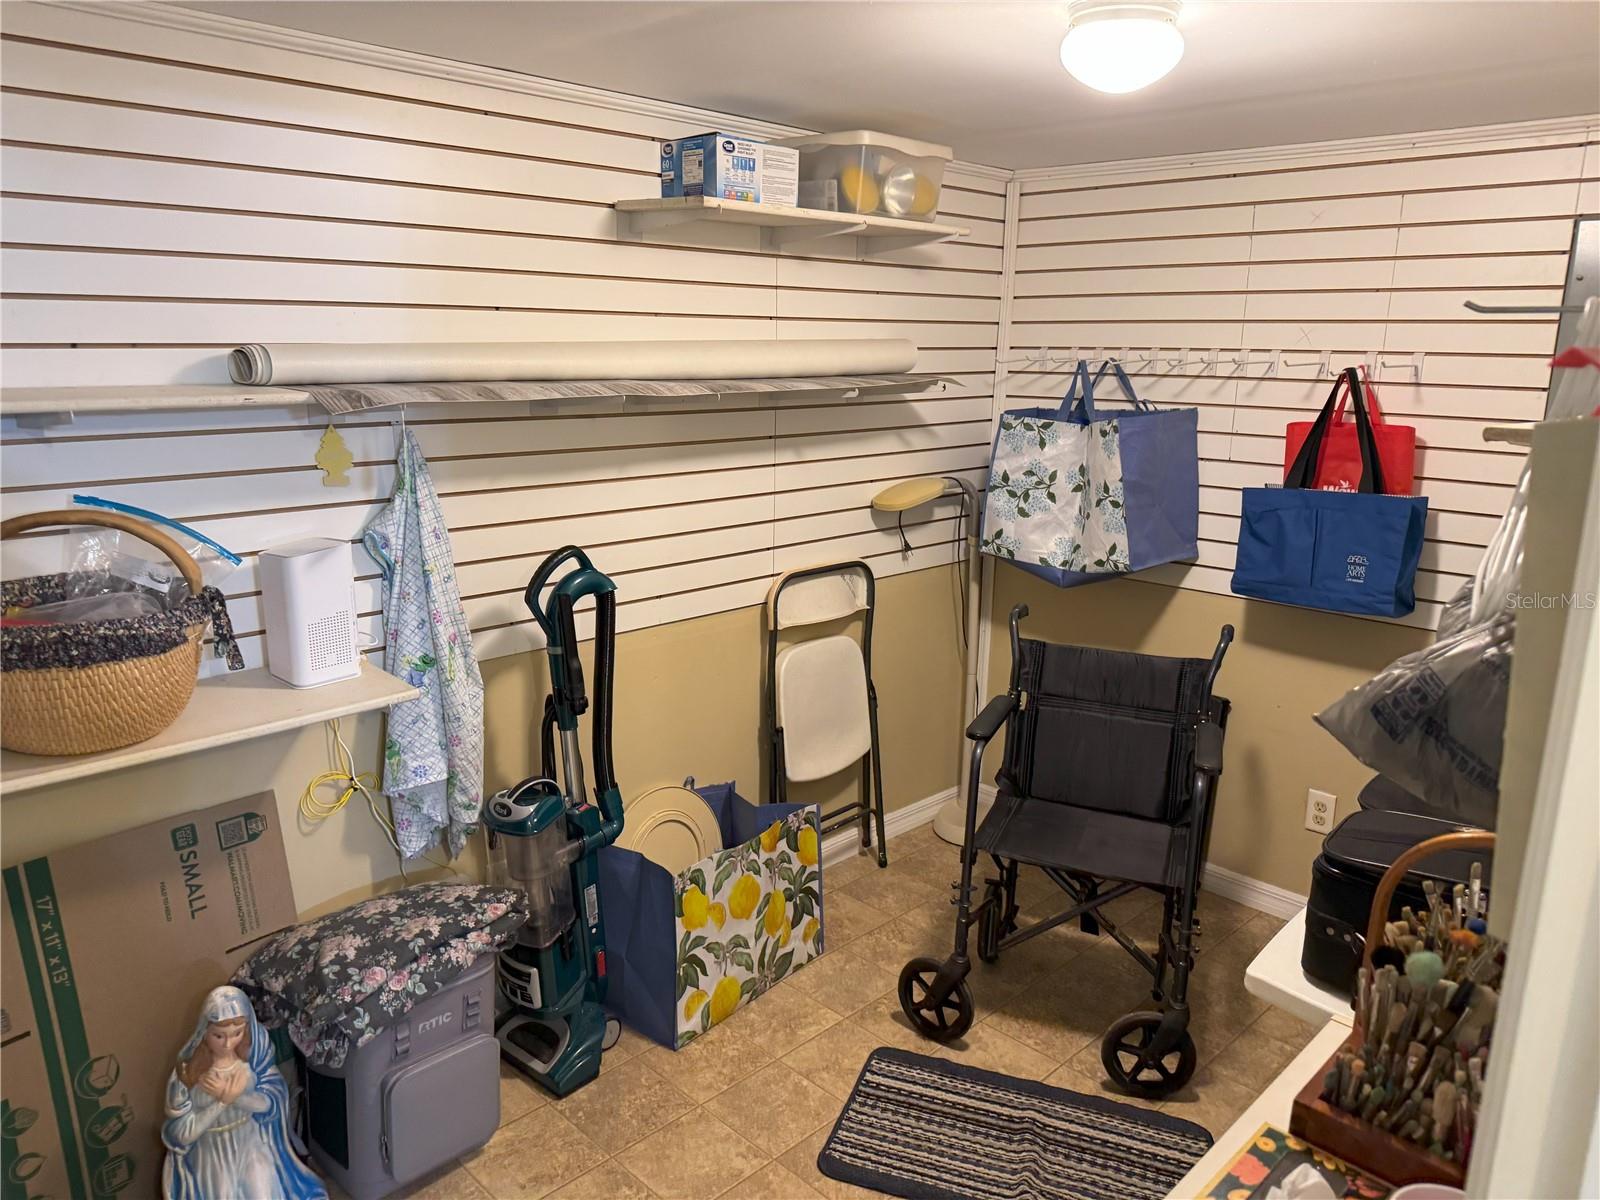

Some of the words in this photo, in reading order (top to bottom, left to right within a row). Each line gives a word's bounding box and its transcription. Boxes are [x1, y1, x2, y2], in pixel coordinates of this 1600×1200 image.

[1346, 570, 1366, 578] ARTS
[179, 850, 208, 920] SMALL
[36, 895, 56, 916] 17"
[41, 921, 53, 932] x
[44, 932, 63, 950] 11"
[49, 956, 60, 966] x
[51, 966, 71, 987] 13"
[418, 1011, 453, 1034] RTIC
